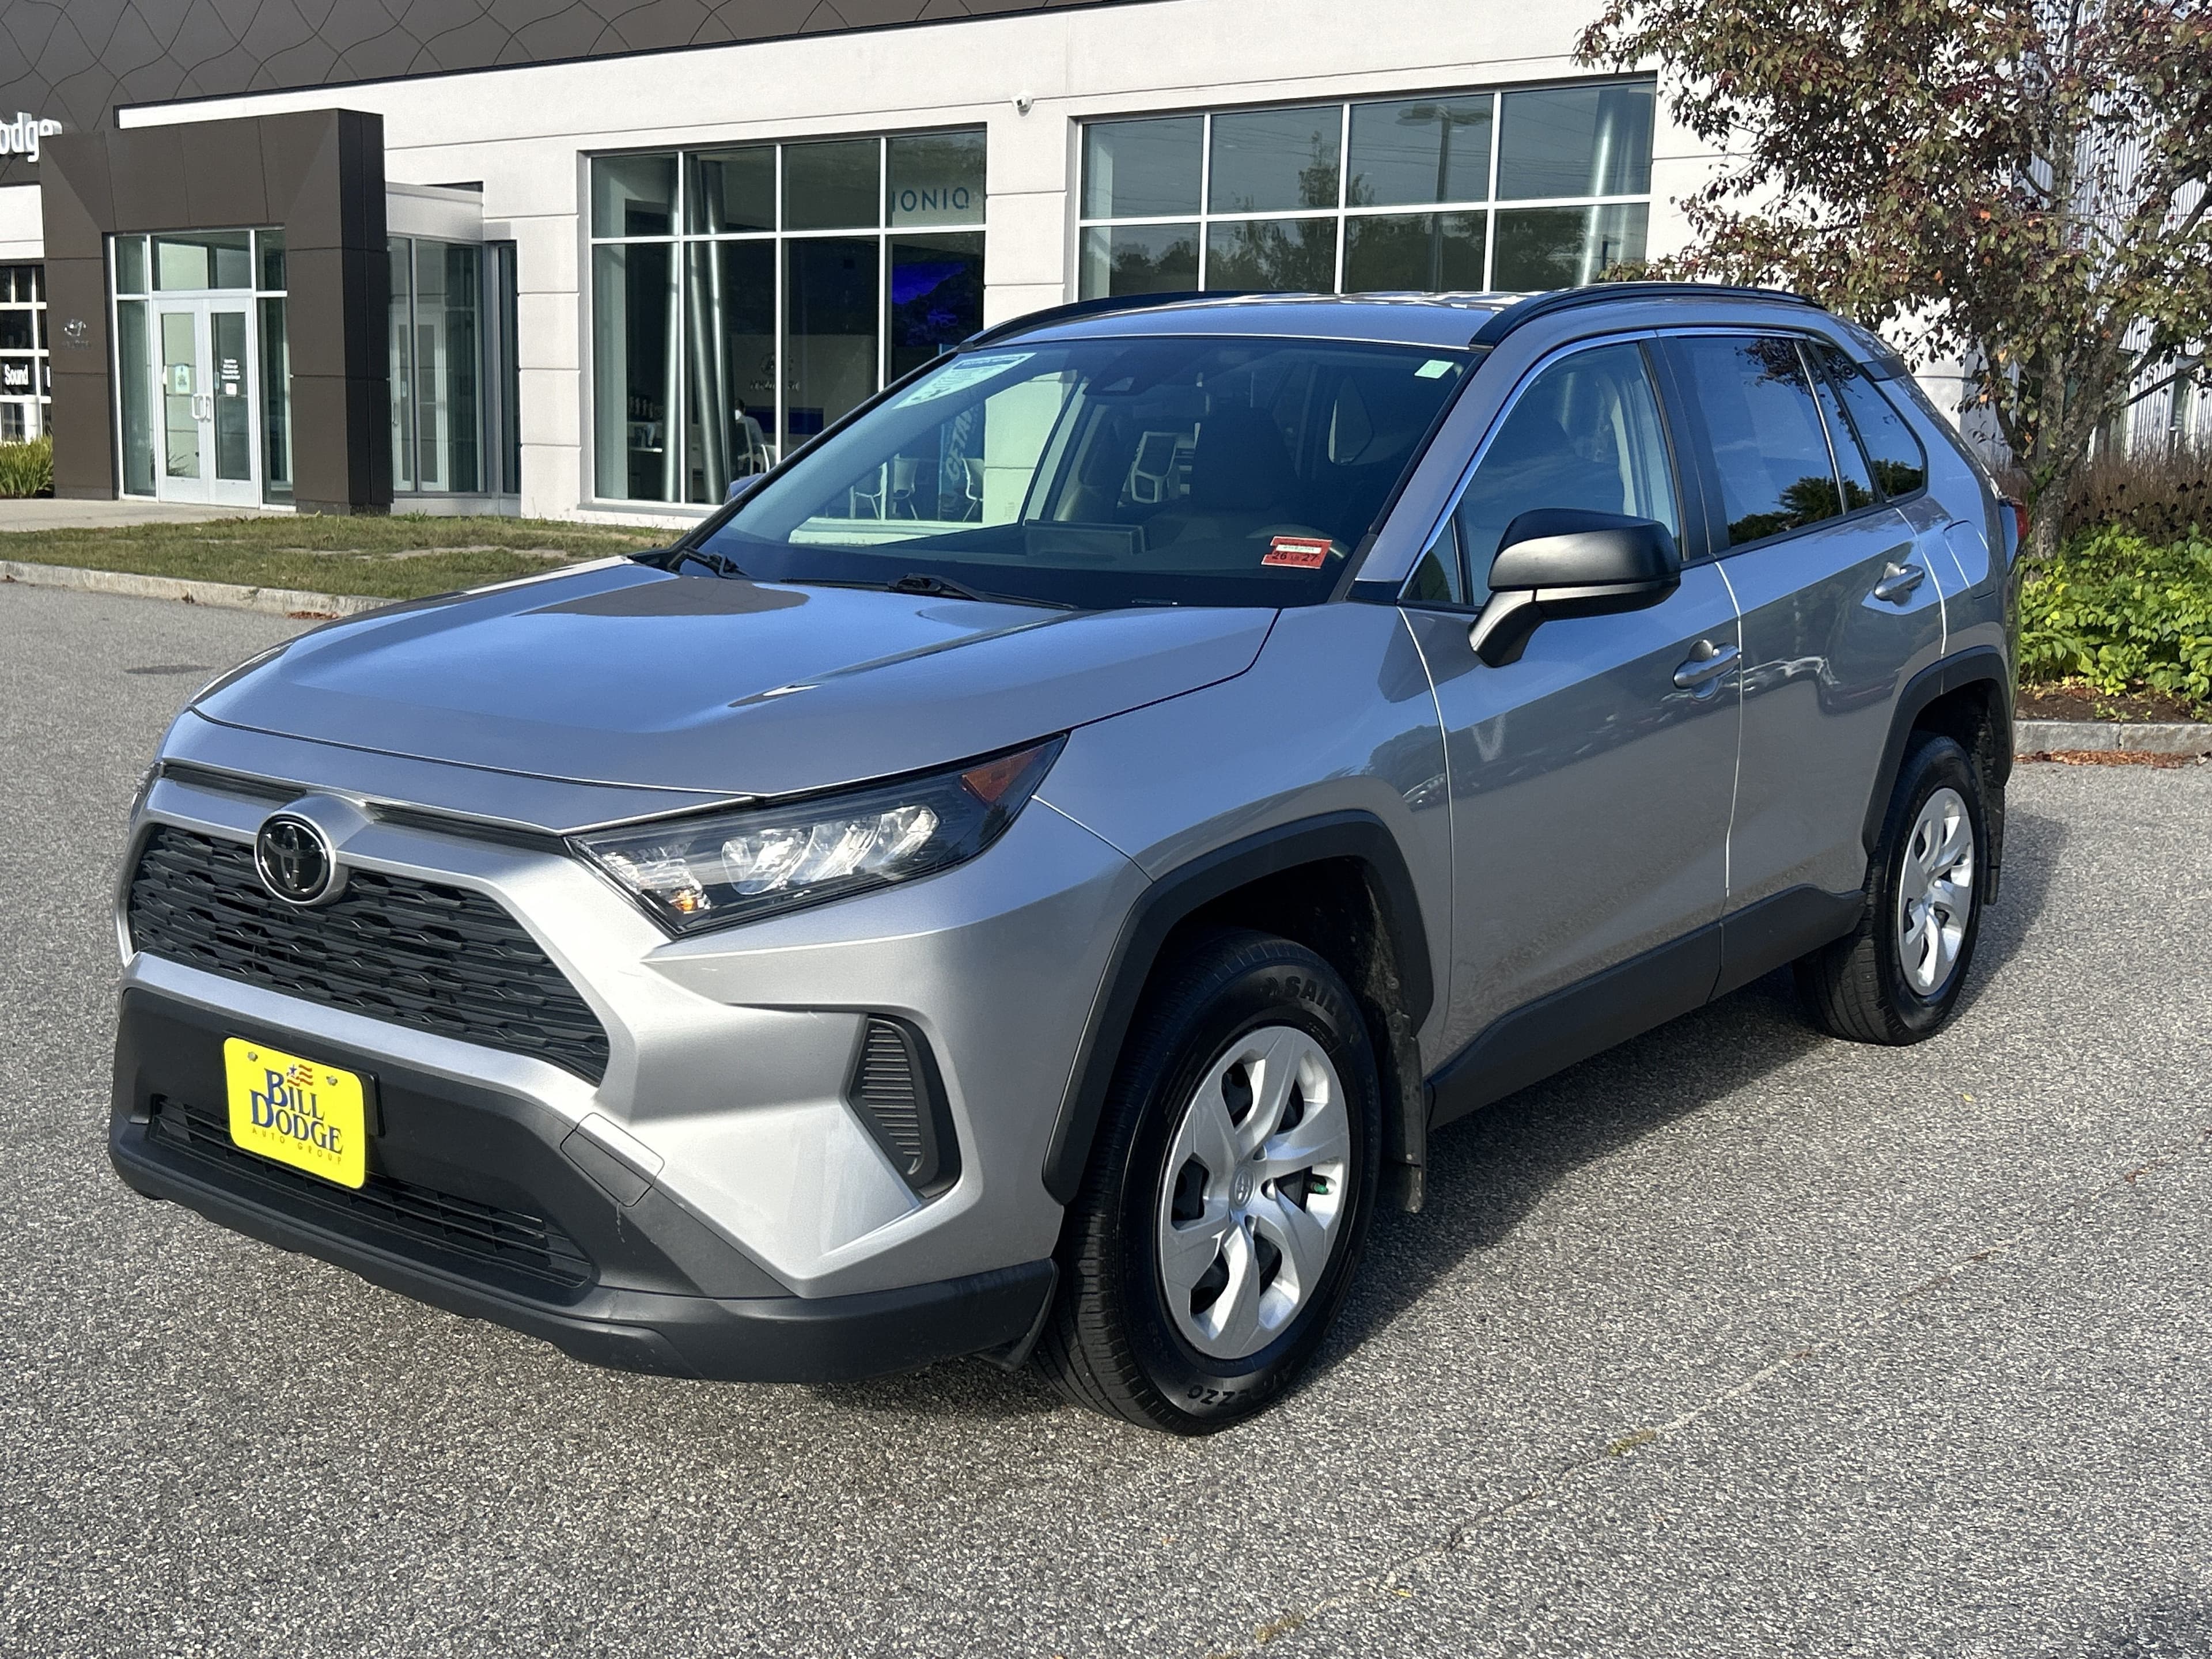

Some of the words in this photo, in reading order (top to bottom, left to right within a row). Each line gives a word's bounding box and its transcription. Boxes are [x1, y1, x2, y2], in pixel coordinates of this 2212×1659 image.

[892, 187, 969, 212] IONIQ
[5, 364, 29, 385] Sound
[264, 1068, 324, 1121] BILL
[249, 1089, 343, 1154] DODGE
[252, 1127, 285, 1143] AUTO
[297, 1142, 342, 1165] GROUP
